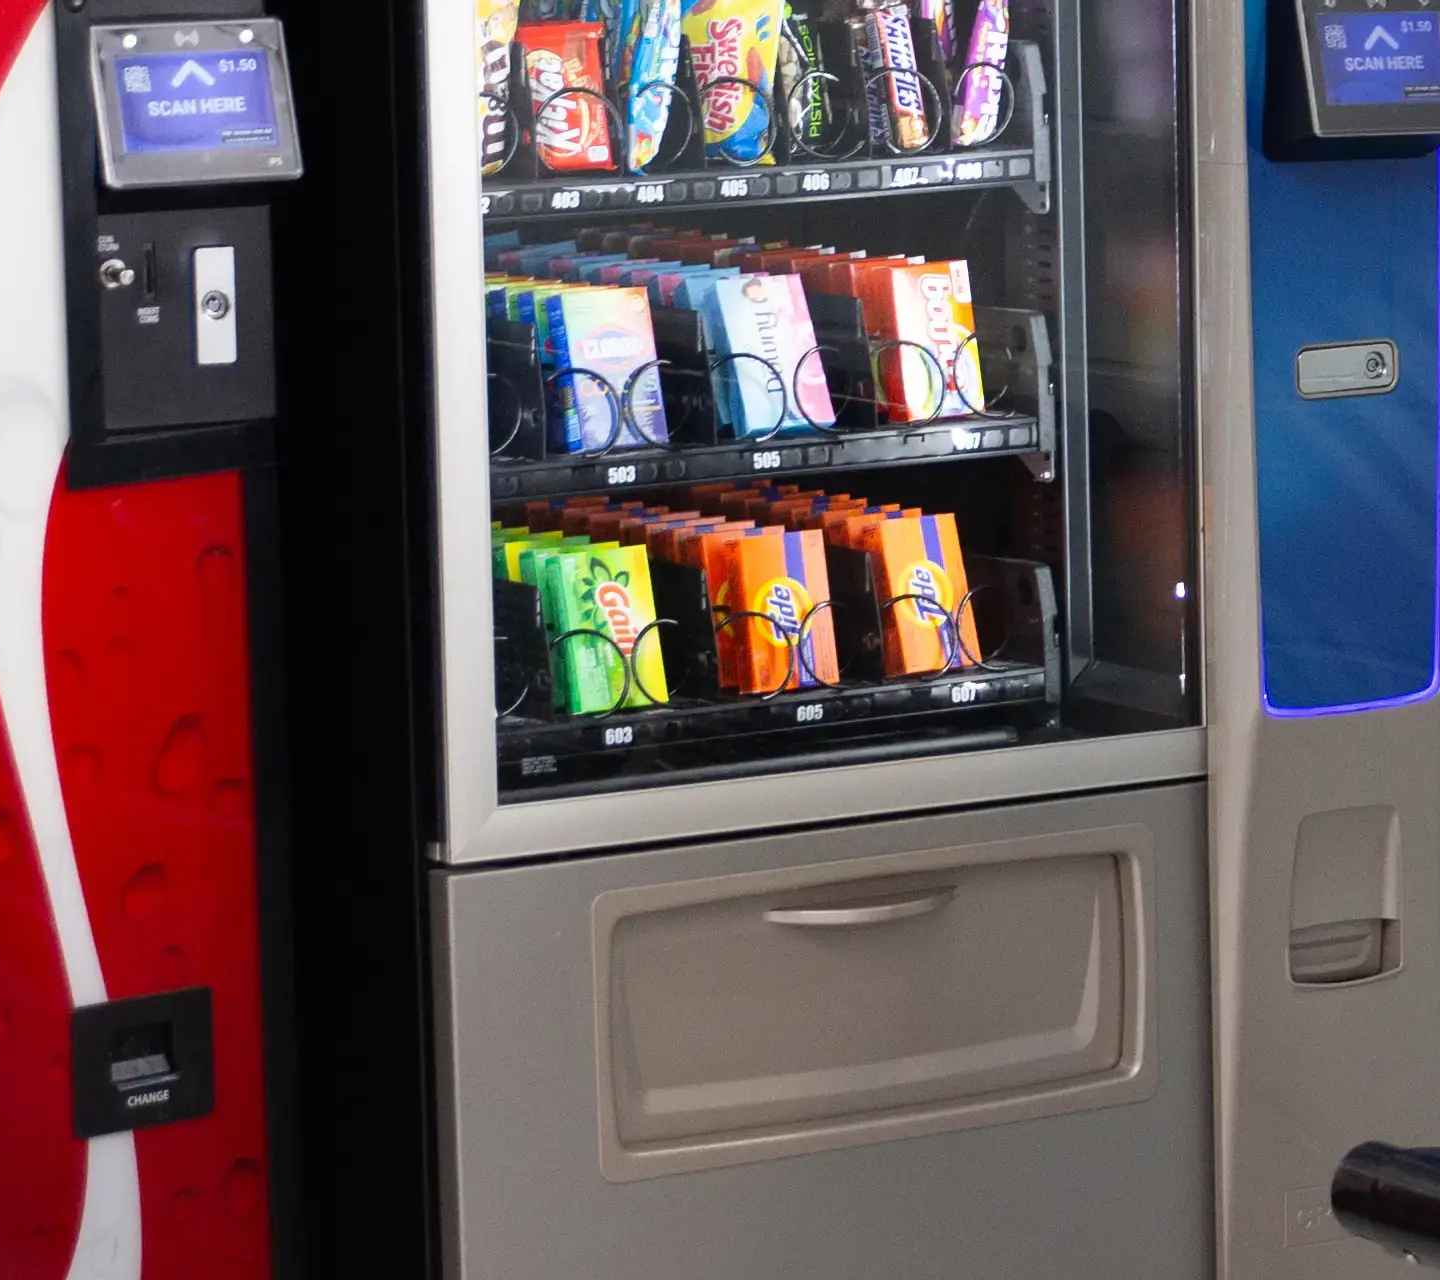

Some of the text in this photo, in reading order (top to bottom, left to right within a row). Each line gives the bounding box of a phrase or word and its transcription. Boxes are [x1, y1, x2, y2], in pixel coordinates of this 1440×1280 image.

[1400, 20, 1432, 34] $1.50
[218, 58, 257, 73] $1.50
[1344, 55, 1425, 71] SCAN HERE
[707, 17, 744, 134] Swedish
[147, 96, 247, 117] SCAN HERE
[720, 179, 747, 196] 405
[802, 174, 830, 190] 406
[552, 192, 580, 208] 403
[638, 185, 664, 202] 404
[754, 311, 782, 393] Downy
[753, 451, 780, 469] 505
[608, 466, 636, 484] 503
[910, 567, 946, 623] Tide
[766, 584, 799, 642] Tide
[952, 686, 976, 703] 607
[797, 705, 823, 721] 605
[605, 727, 633, 746] 603
[127, 1089, 170, 1107] CHANGE
